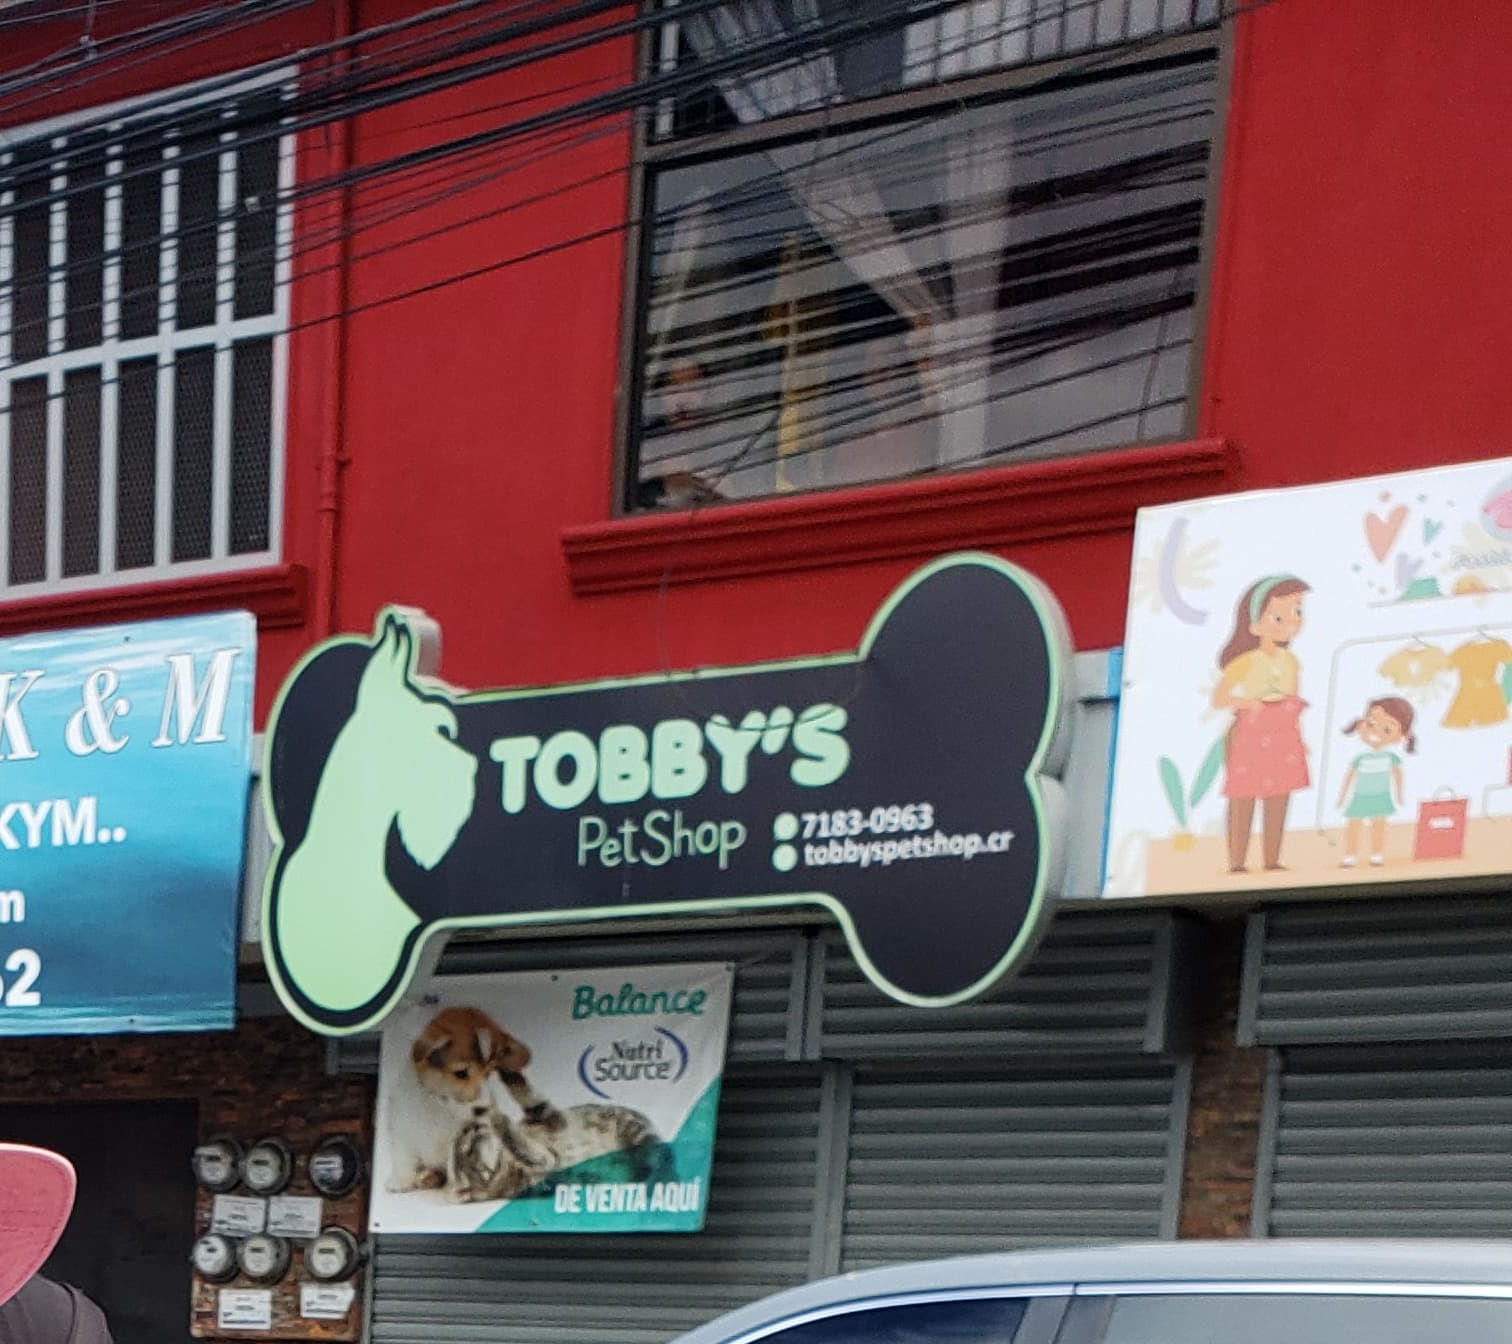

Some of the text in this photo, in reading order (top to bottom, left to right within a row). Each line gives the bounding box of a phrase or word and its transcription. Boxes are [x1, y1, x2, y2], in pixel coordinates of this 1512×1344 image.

[65, 666, 130, 756] &
[152, 647, 241, 748] M
[489, 703, 851, 815] TOBBY'S
[801, 803, 935, 840] 7183-0963
[804, 831, 1015, 868] tobbyspetshop.cr
[572, 983, 709, 1020] Balance
[611, 1039, 665, 1061] Nutri
[594, 1058, 671, 1082] Source
[554, 1183, 582, 1213] DE
[587, 1181, 647, 1213] VENTA
